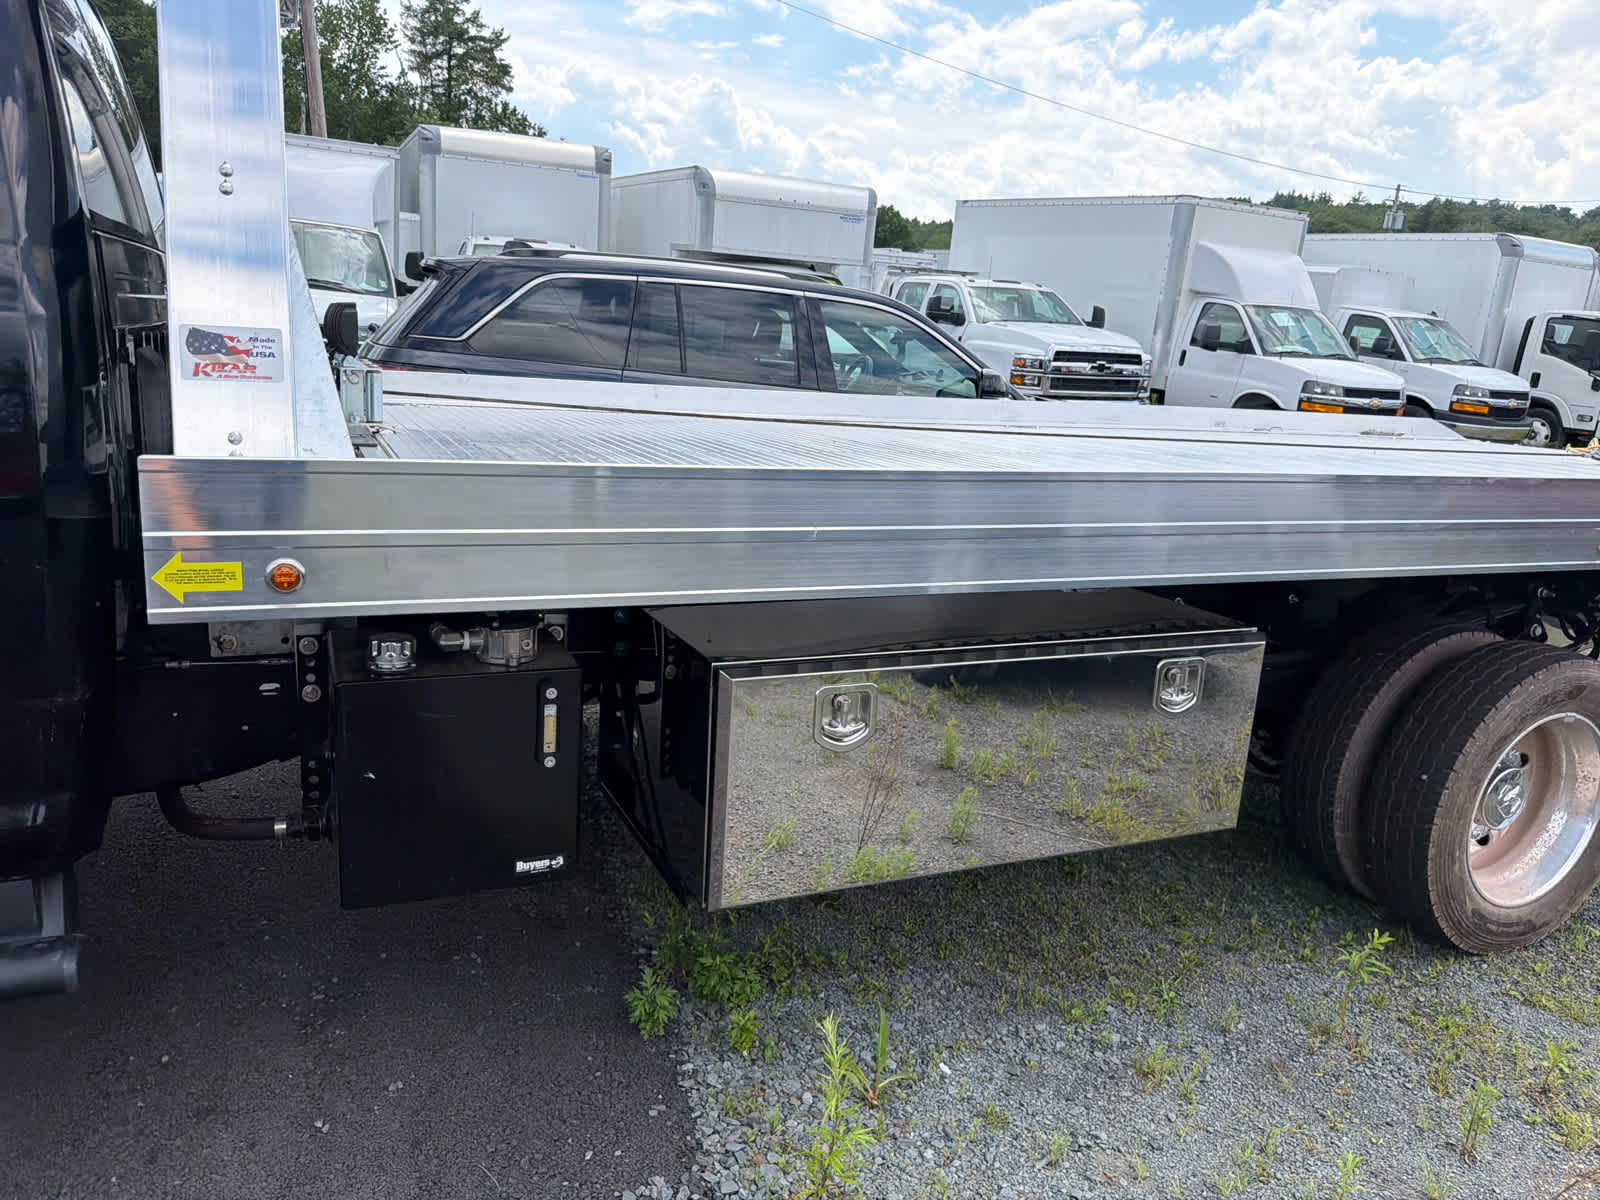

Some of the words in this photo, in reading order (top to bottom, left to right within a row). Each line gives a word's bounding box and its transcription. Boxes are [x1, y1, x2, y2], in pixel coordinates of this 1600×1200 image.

[248, 336, 276, 344] Made
[250, 351, 276, 359] USA
[515, 858, 550, 873] Buyers
